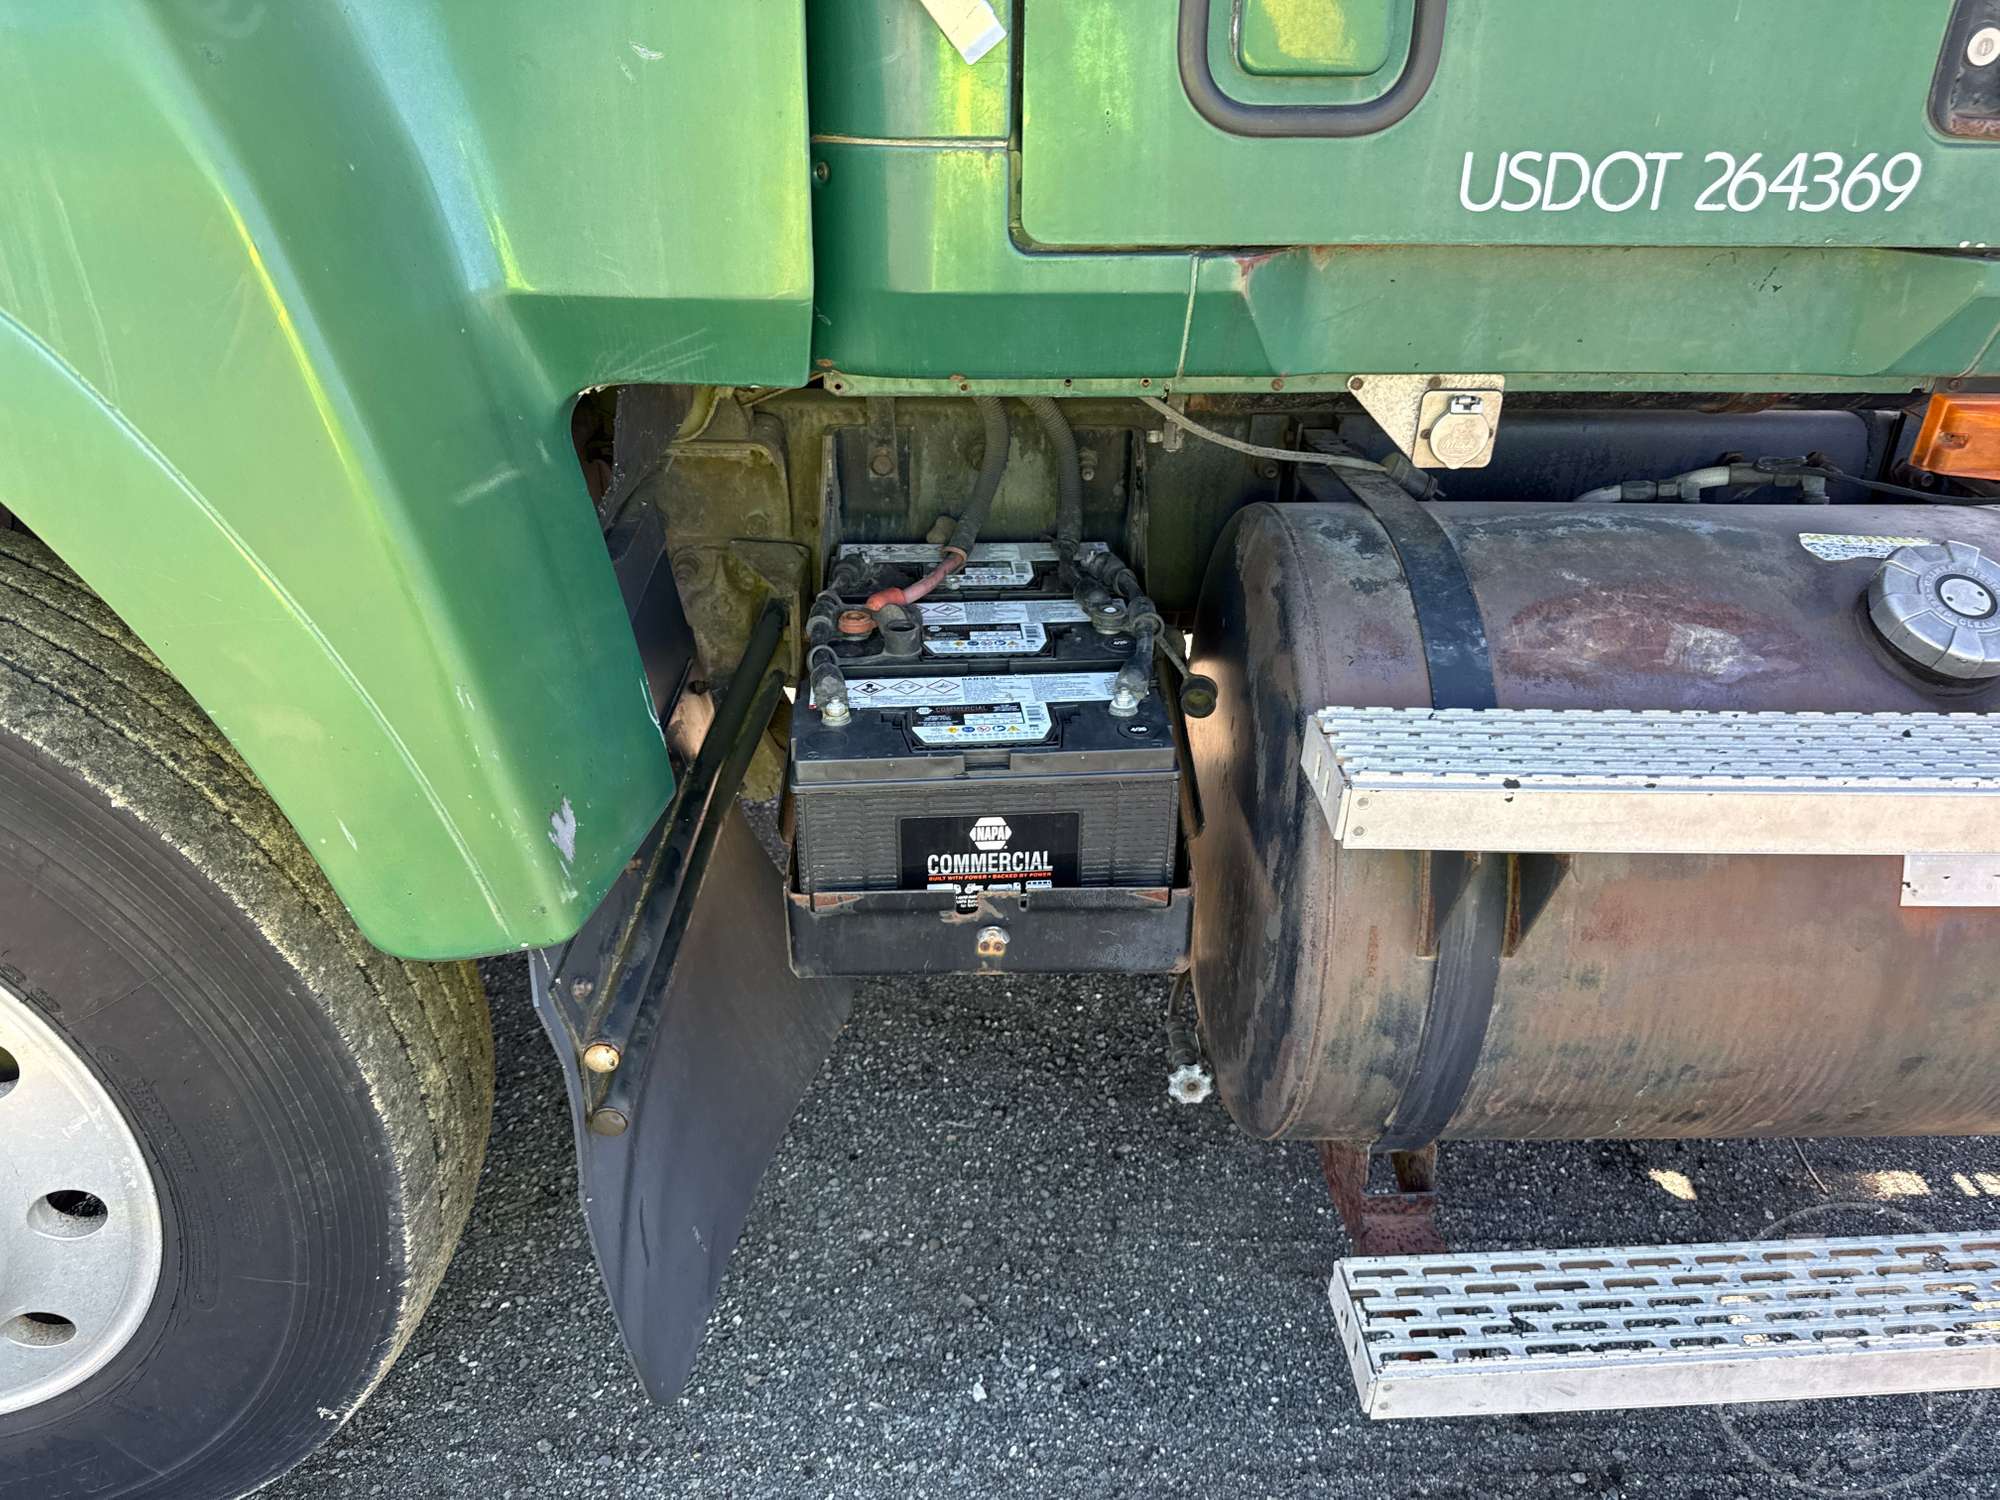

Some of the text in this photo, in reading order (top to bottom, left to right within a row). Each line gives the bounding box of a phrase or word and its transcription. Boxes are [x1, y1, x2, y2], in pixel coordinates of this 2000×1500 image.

[1459, 150, 1922, 213] USDOT 264369
[935, 705, 988, 714] COMMERCIAL
[977, 826, 1006, 842] NAPA
[927, 850, 1053, 874] COMMERCIAL
